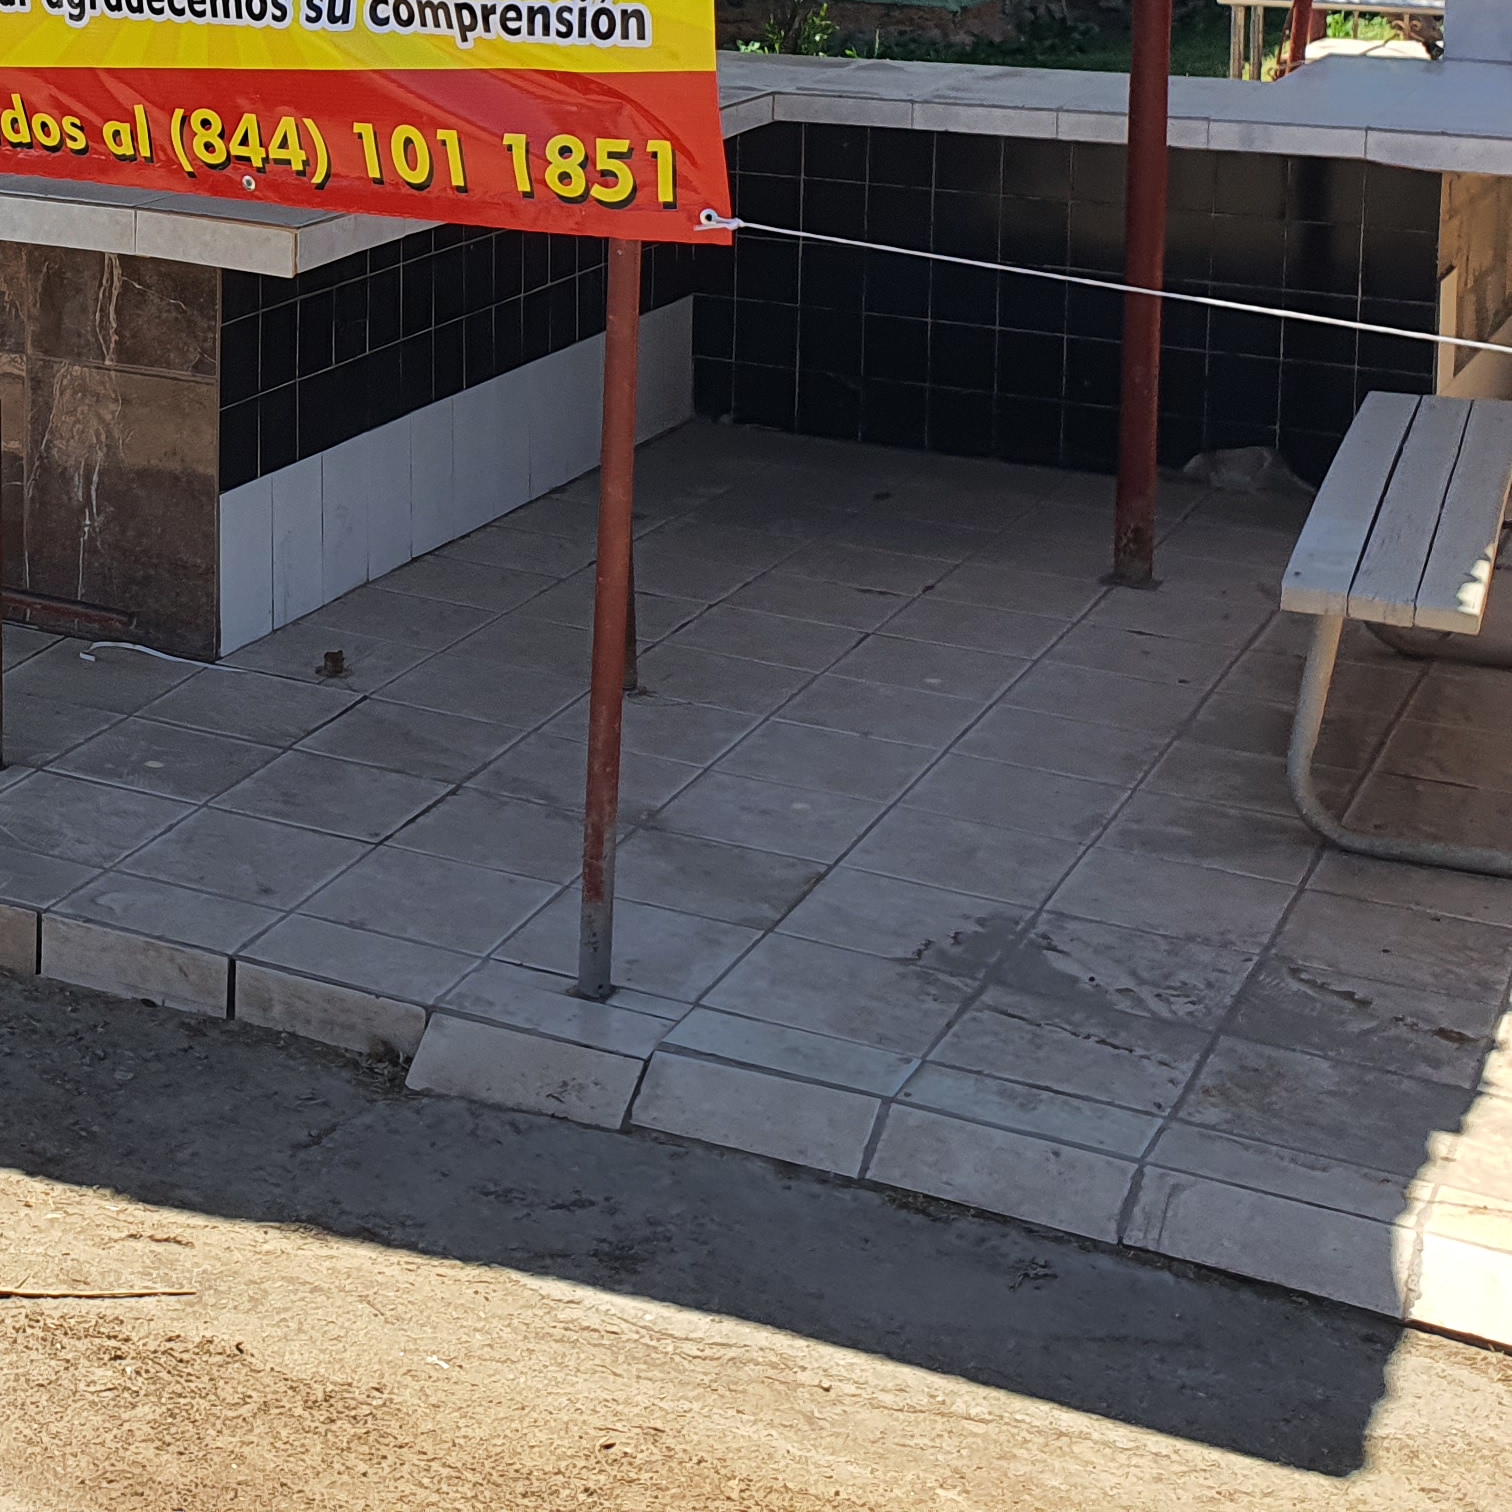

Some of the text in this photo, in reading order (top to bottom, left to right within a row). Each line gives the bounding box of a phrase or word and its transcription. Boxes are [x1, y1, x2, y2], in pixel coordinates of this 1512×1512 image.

[102, 103, 152, 162] al
[171, 107, 330, 187] (844)
[352, 122, 467, 190] 101
[503, 132, 676, 207] 1851
